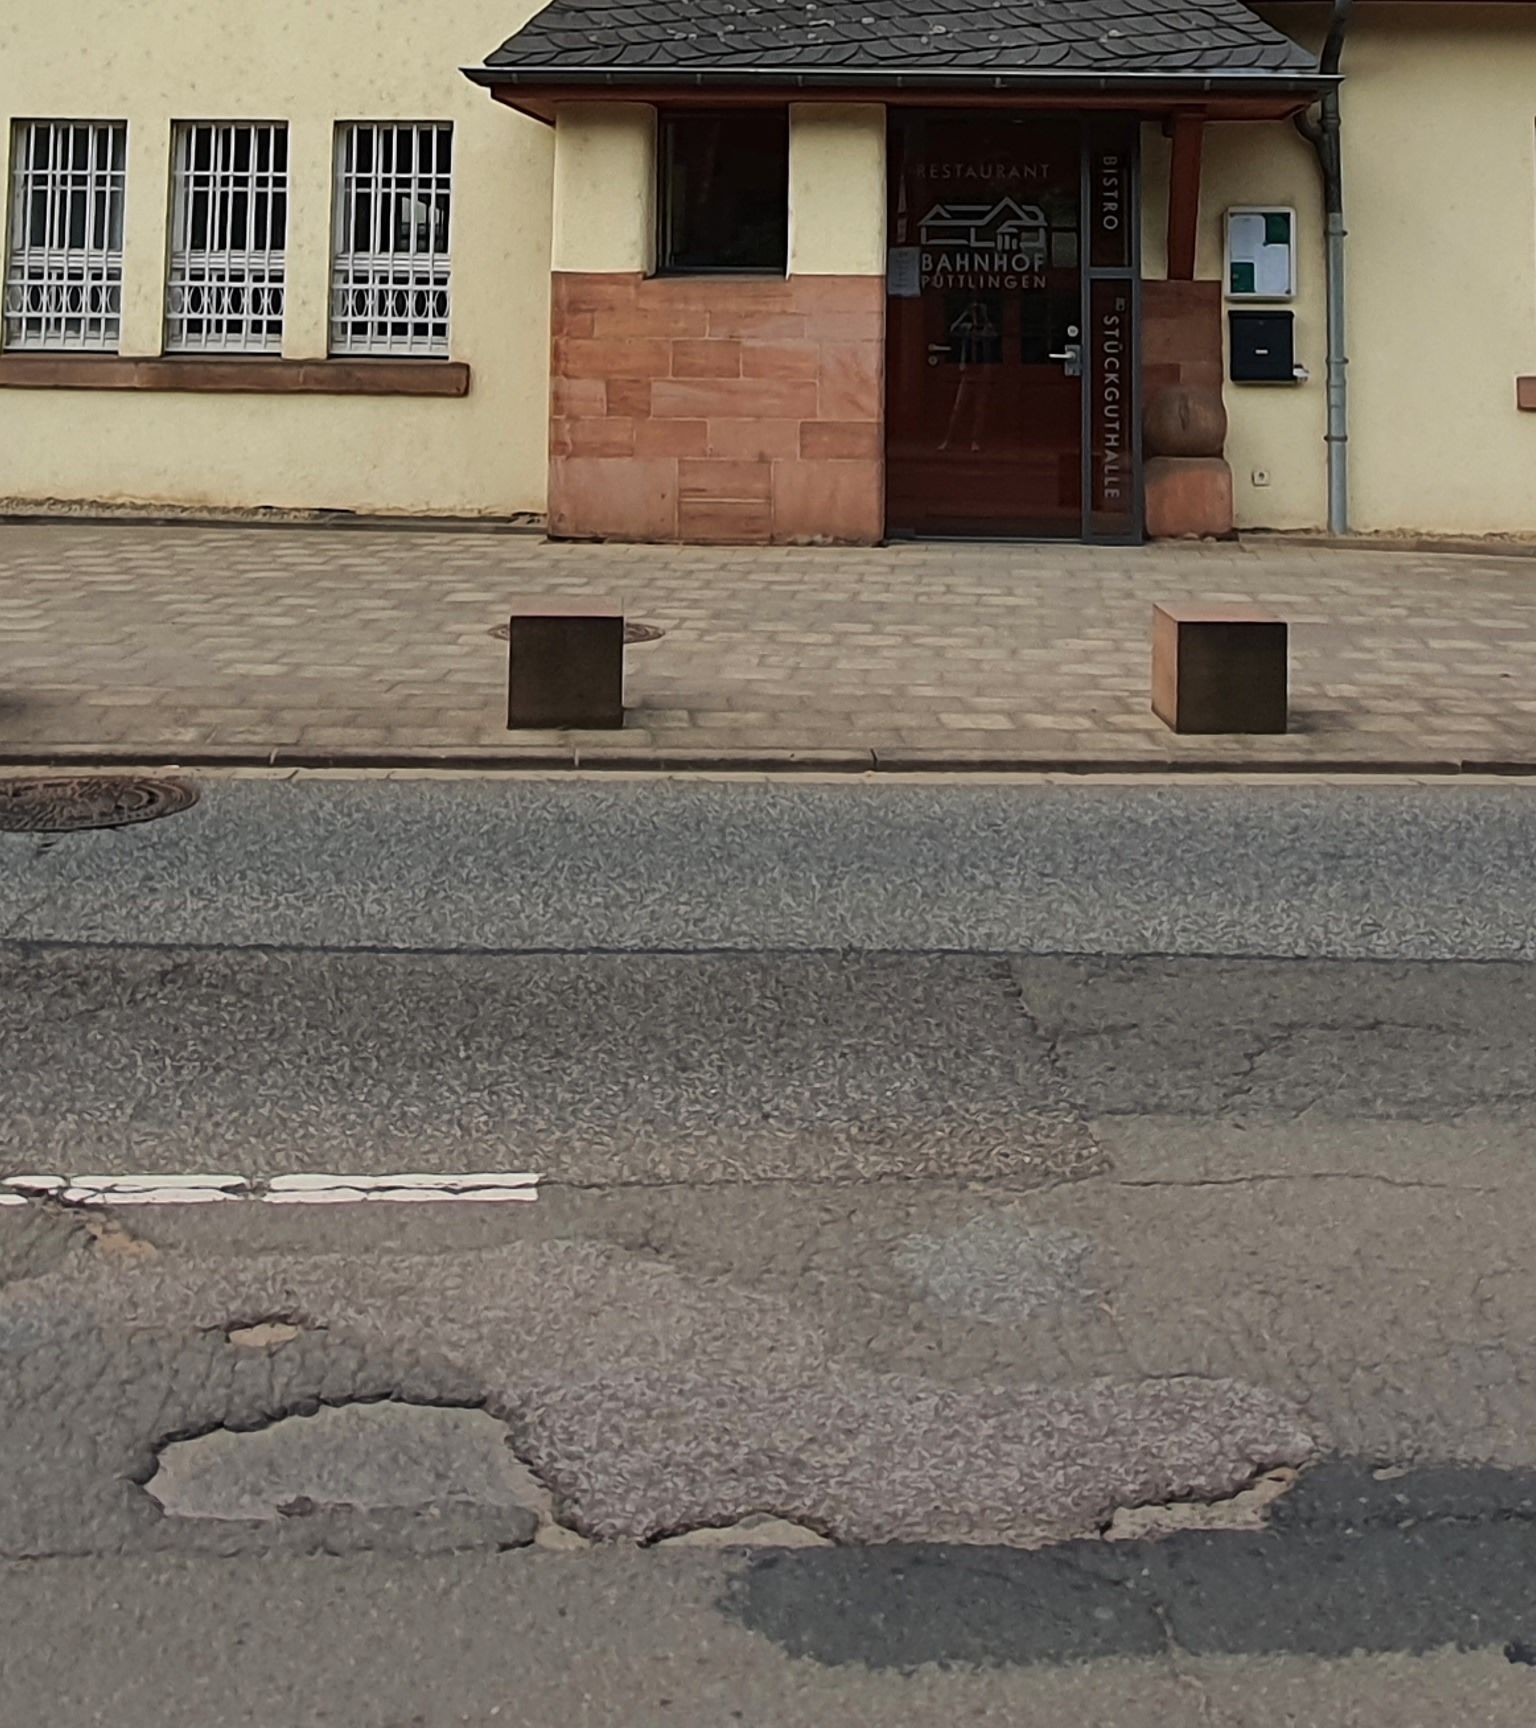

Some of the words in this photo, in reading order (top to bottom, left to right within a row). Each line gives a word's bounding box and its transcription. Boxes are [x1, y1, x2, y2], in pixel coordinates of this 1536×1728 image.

[917, 163, 1050, 179] RESTAURANT
[1102, 155, 1119, 230] BISTRO
[921, 252, 1045, 273] BAHNHOF
[921, 273, 1047, 289] PÜTTLINGEN
[1103, 314, 1123, 498] STÜCKGUTHALLE
